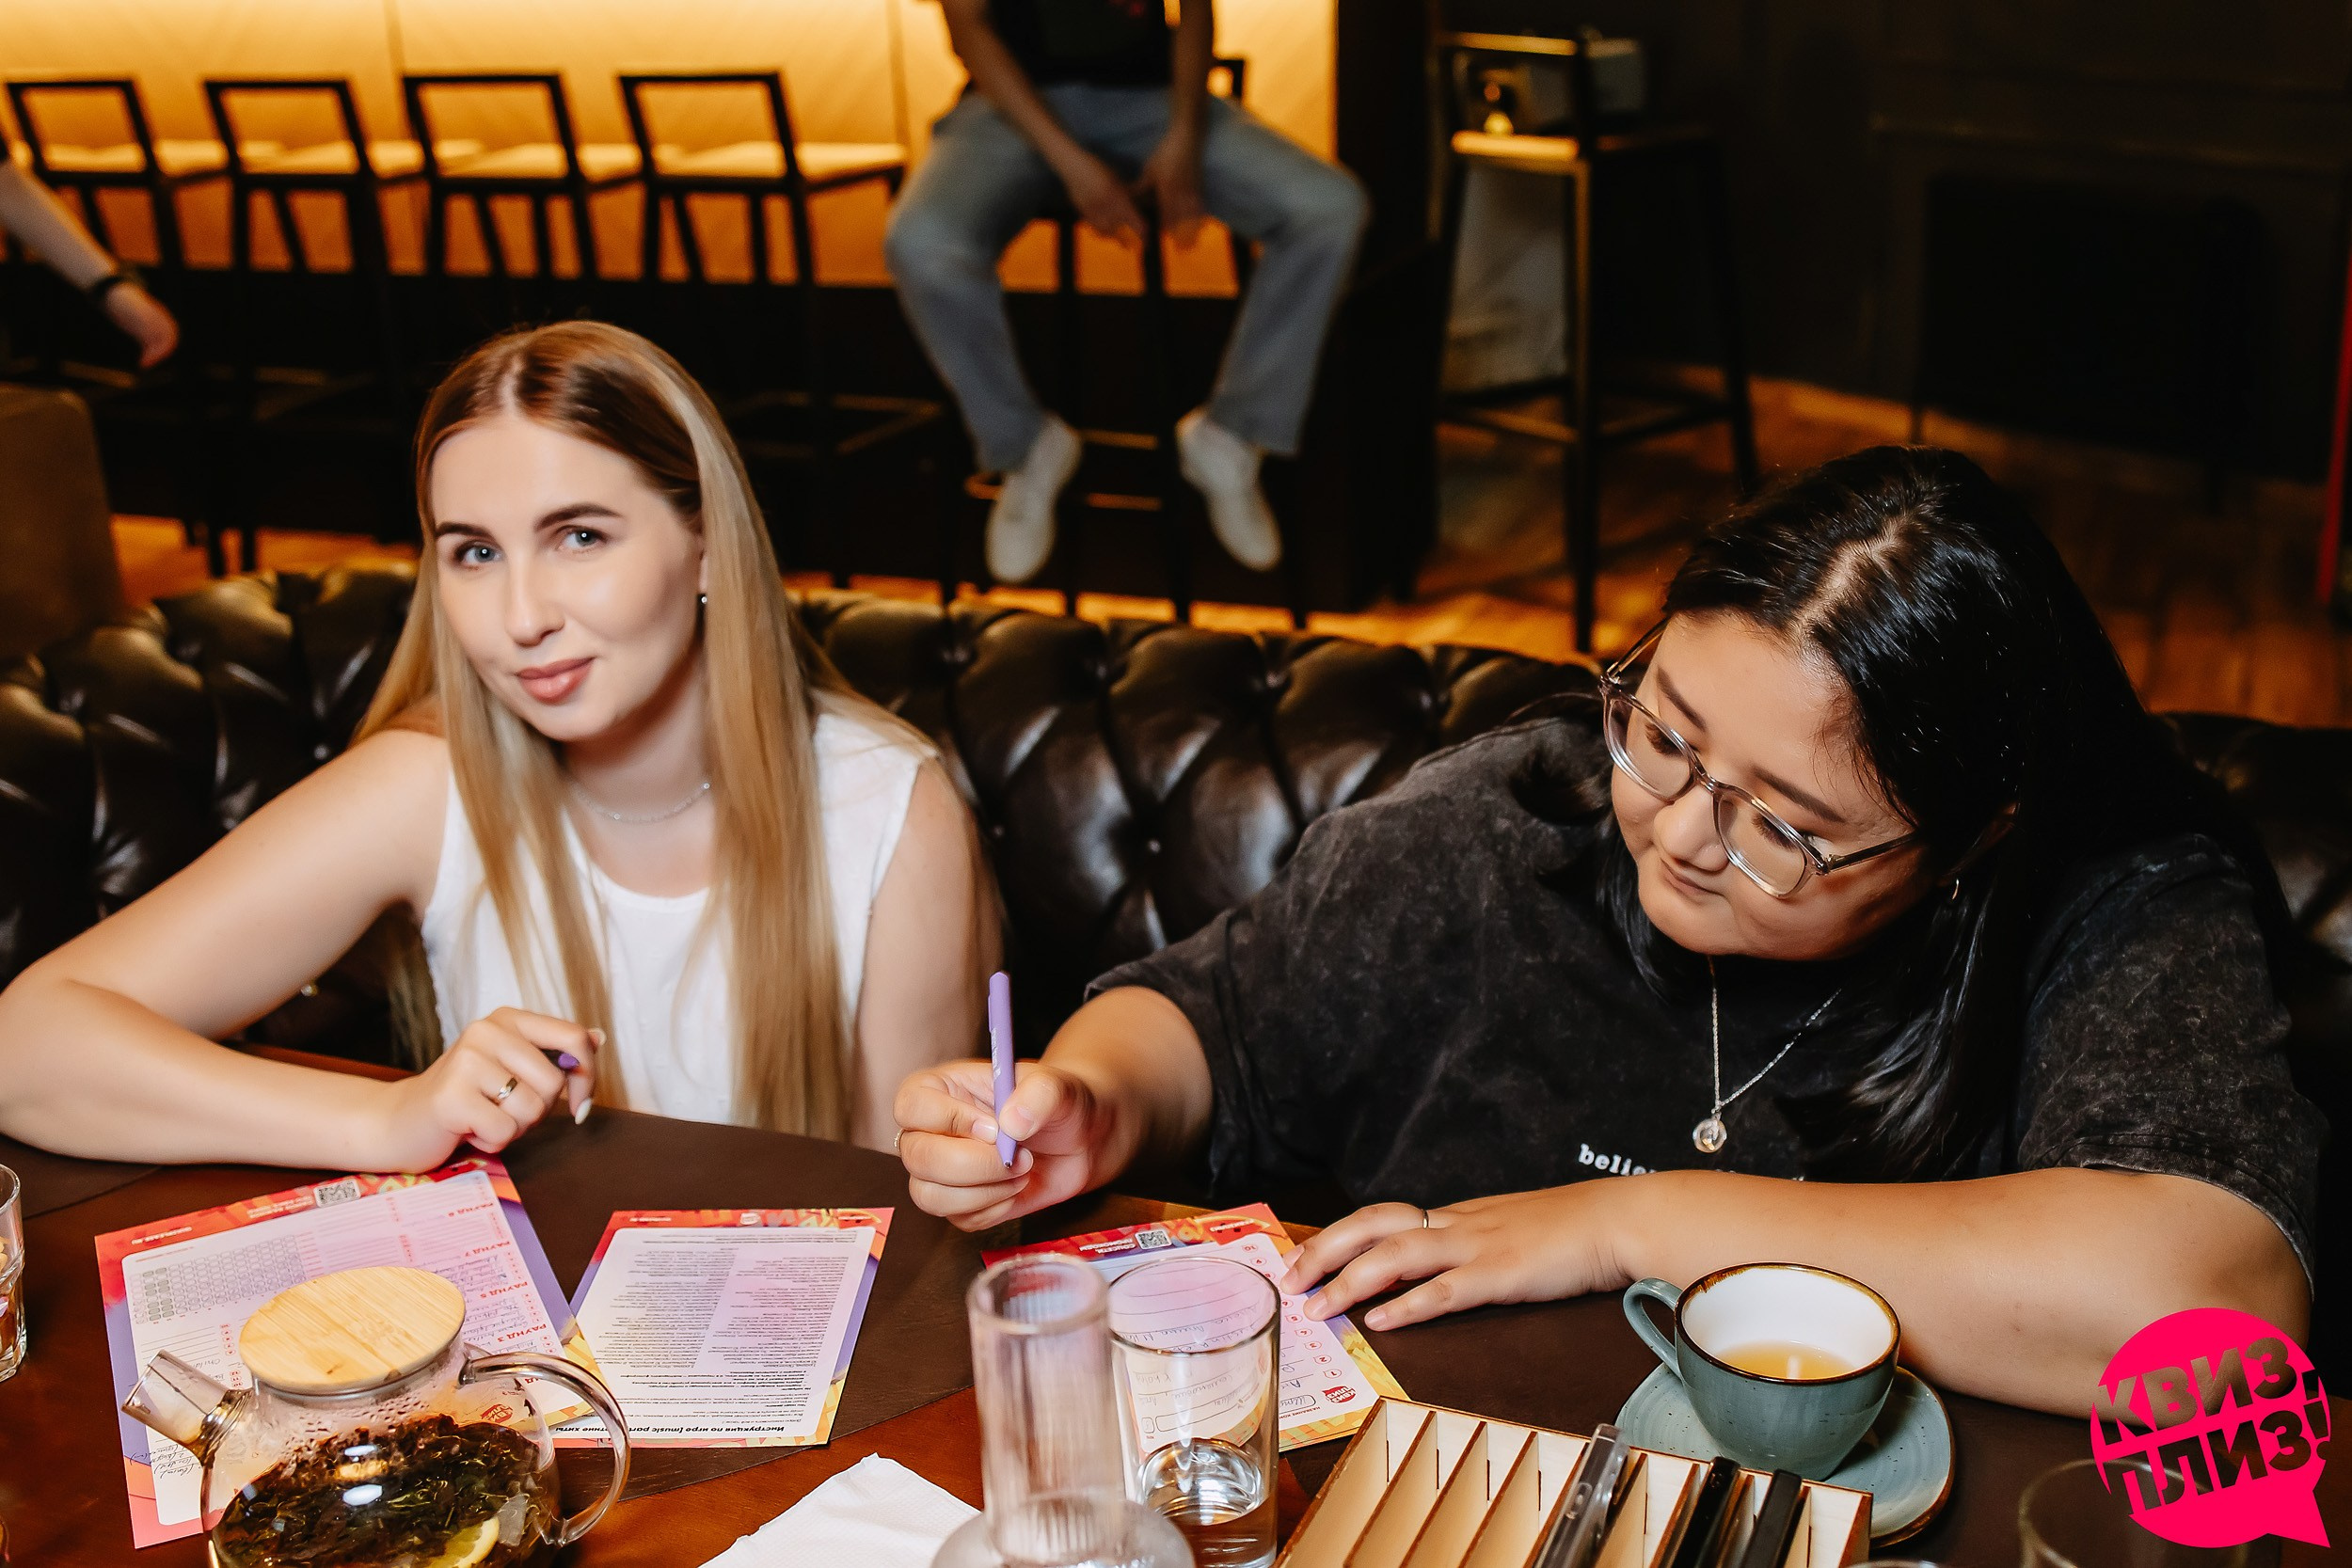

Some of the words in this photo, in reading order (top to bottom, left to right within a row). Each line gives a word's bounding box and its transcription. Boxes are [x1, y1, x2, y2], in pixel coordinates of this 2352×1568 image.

[1578, 1143, 1657, 1176] belie
[489, 1281, 527, 1296] РАУНД
[506, 1323, 547, 1339] РАУНД
